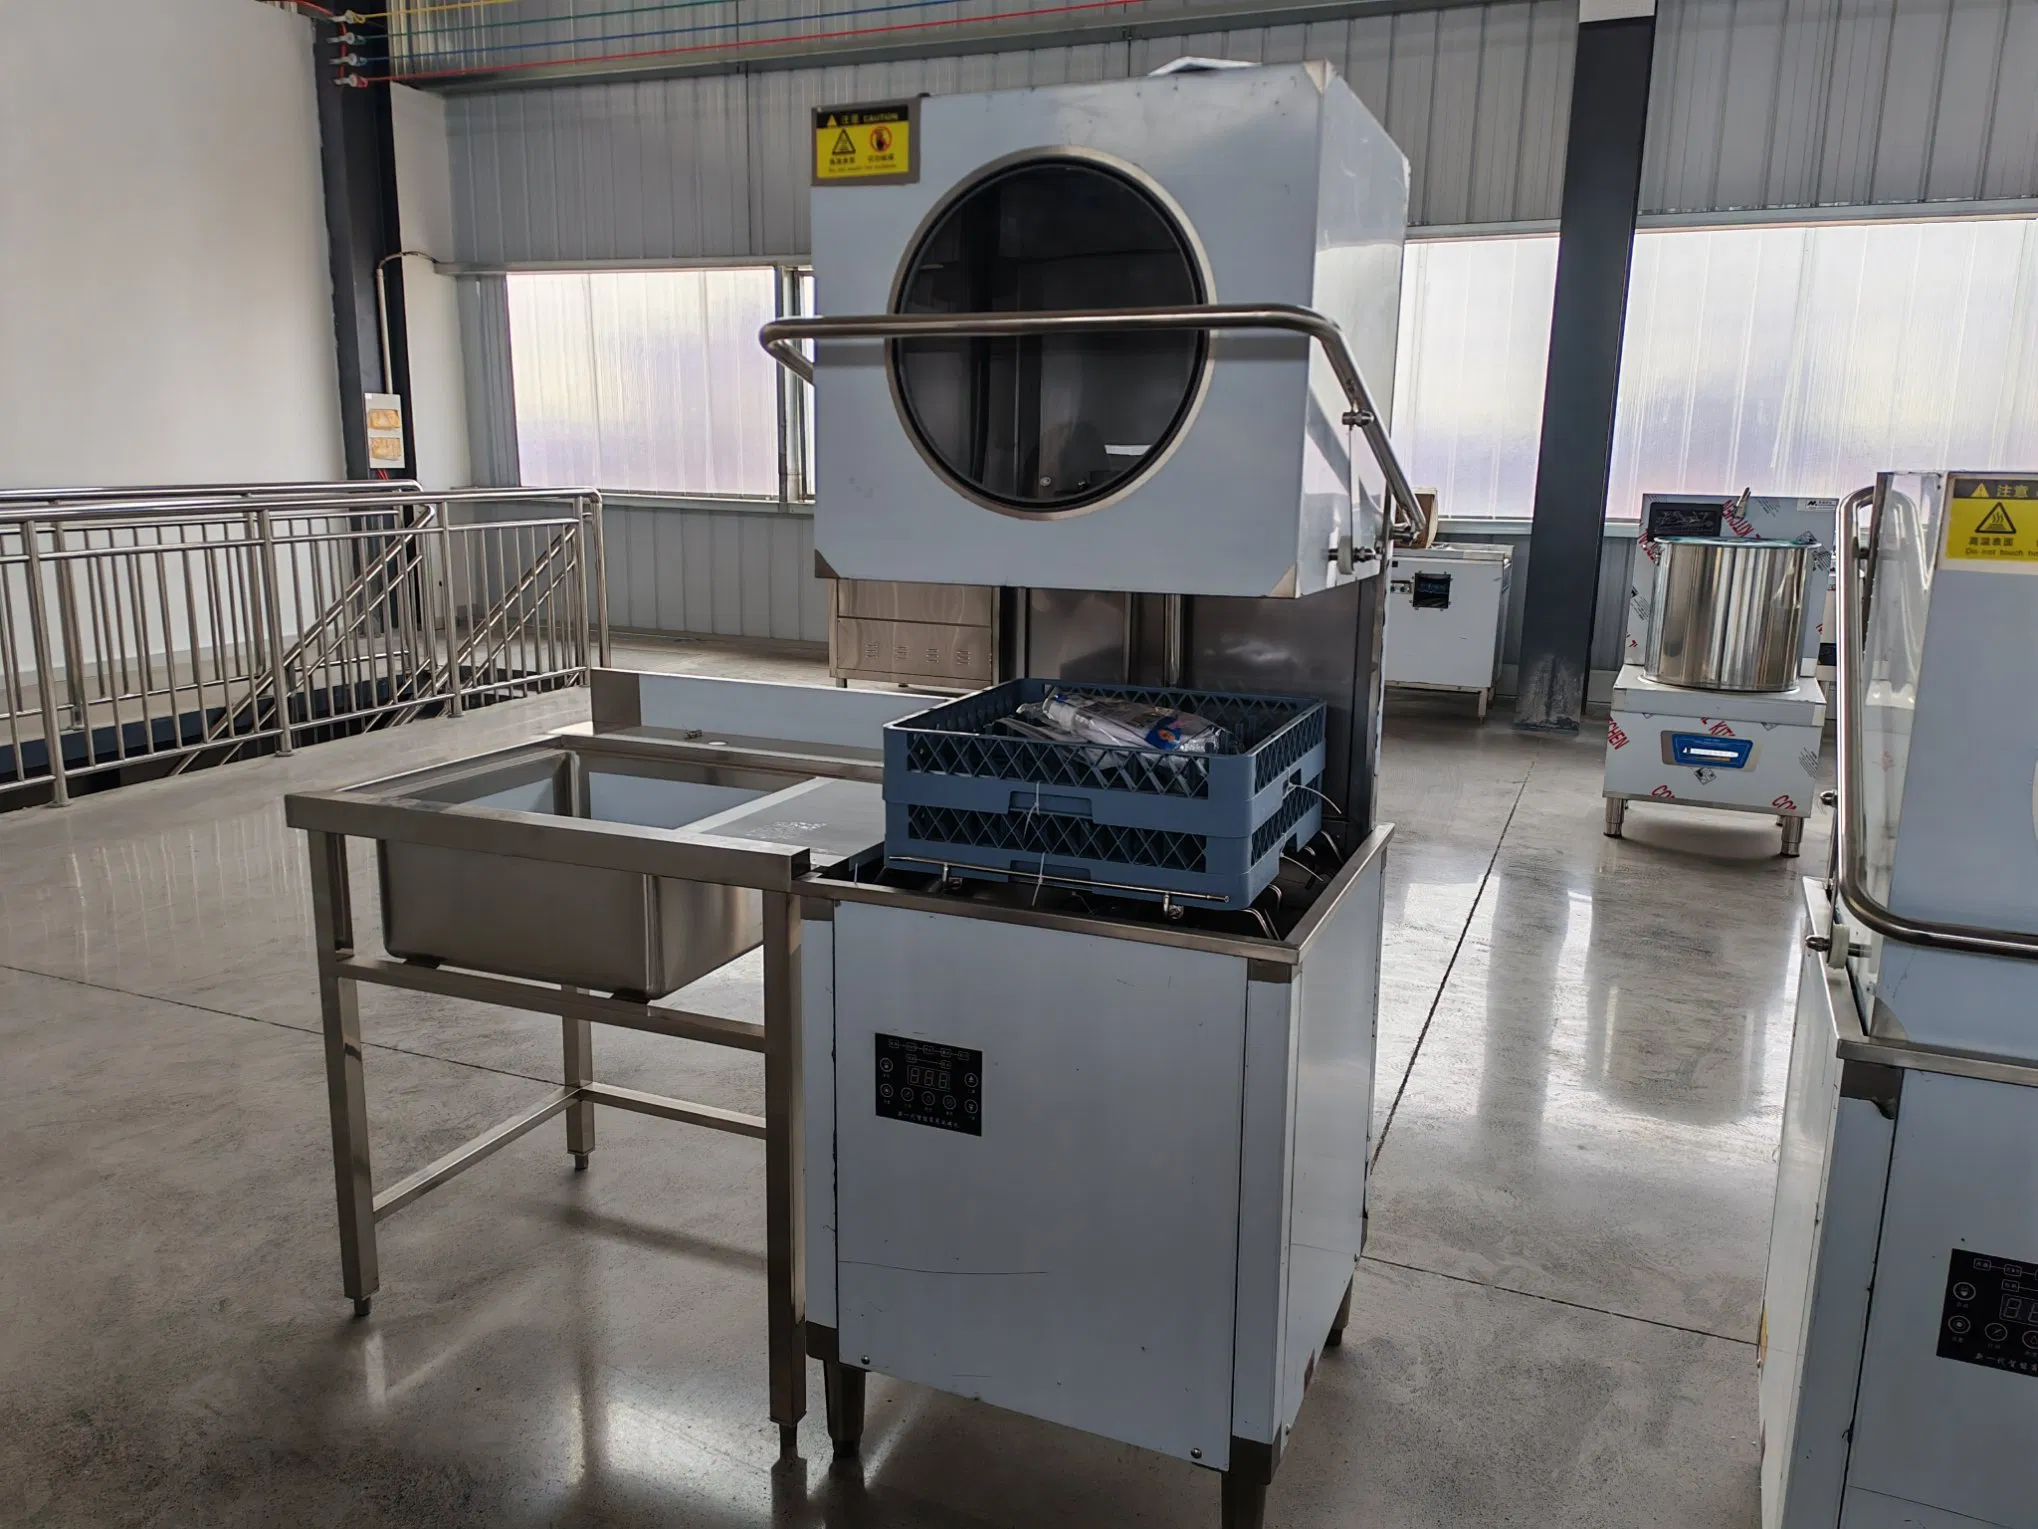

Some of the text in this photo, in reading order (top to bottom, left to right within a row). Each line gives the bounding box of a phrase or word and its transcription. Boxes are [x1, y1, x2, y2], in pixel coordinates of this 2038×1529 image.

[1996, 484, 2029, 498] 注意
[1969, 537, 2013, 546] 高温表面
[1965, 547, 1978, 555] Do
[1999, 549, 2024, 557] touch
[1708, 720, 1736, 737] KIT
